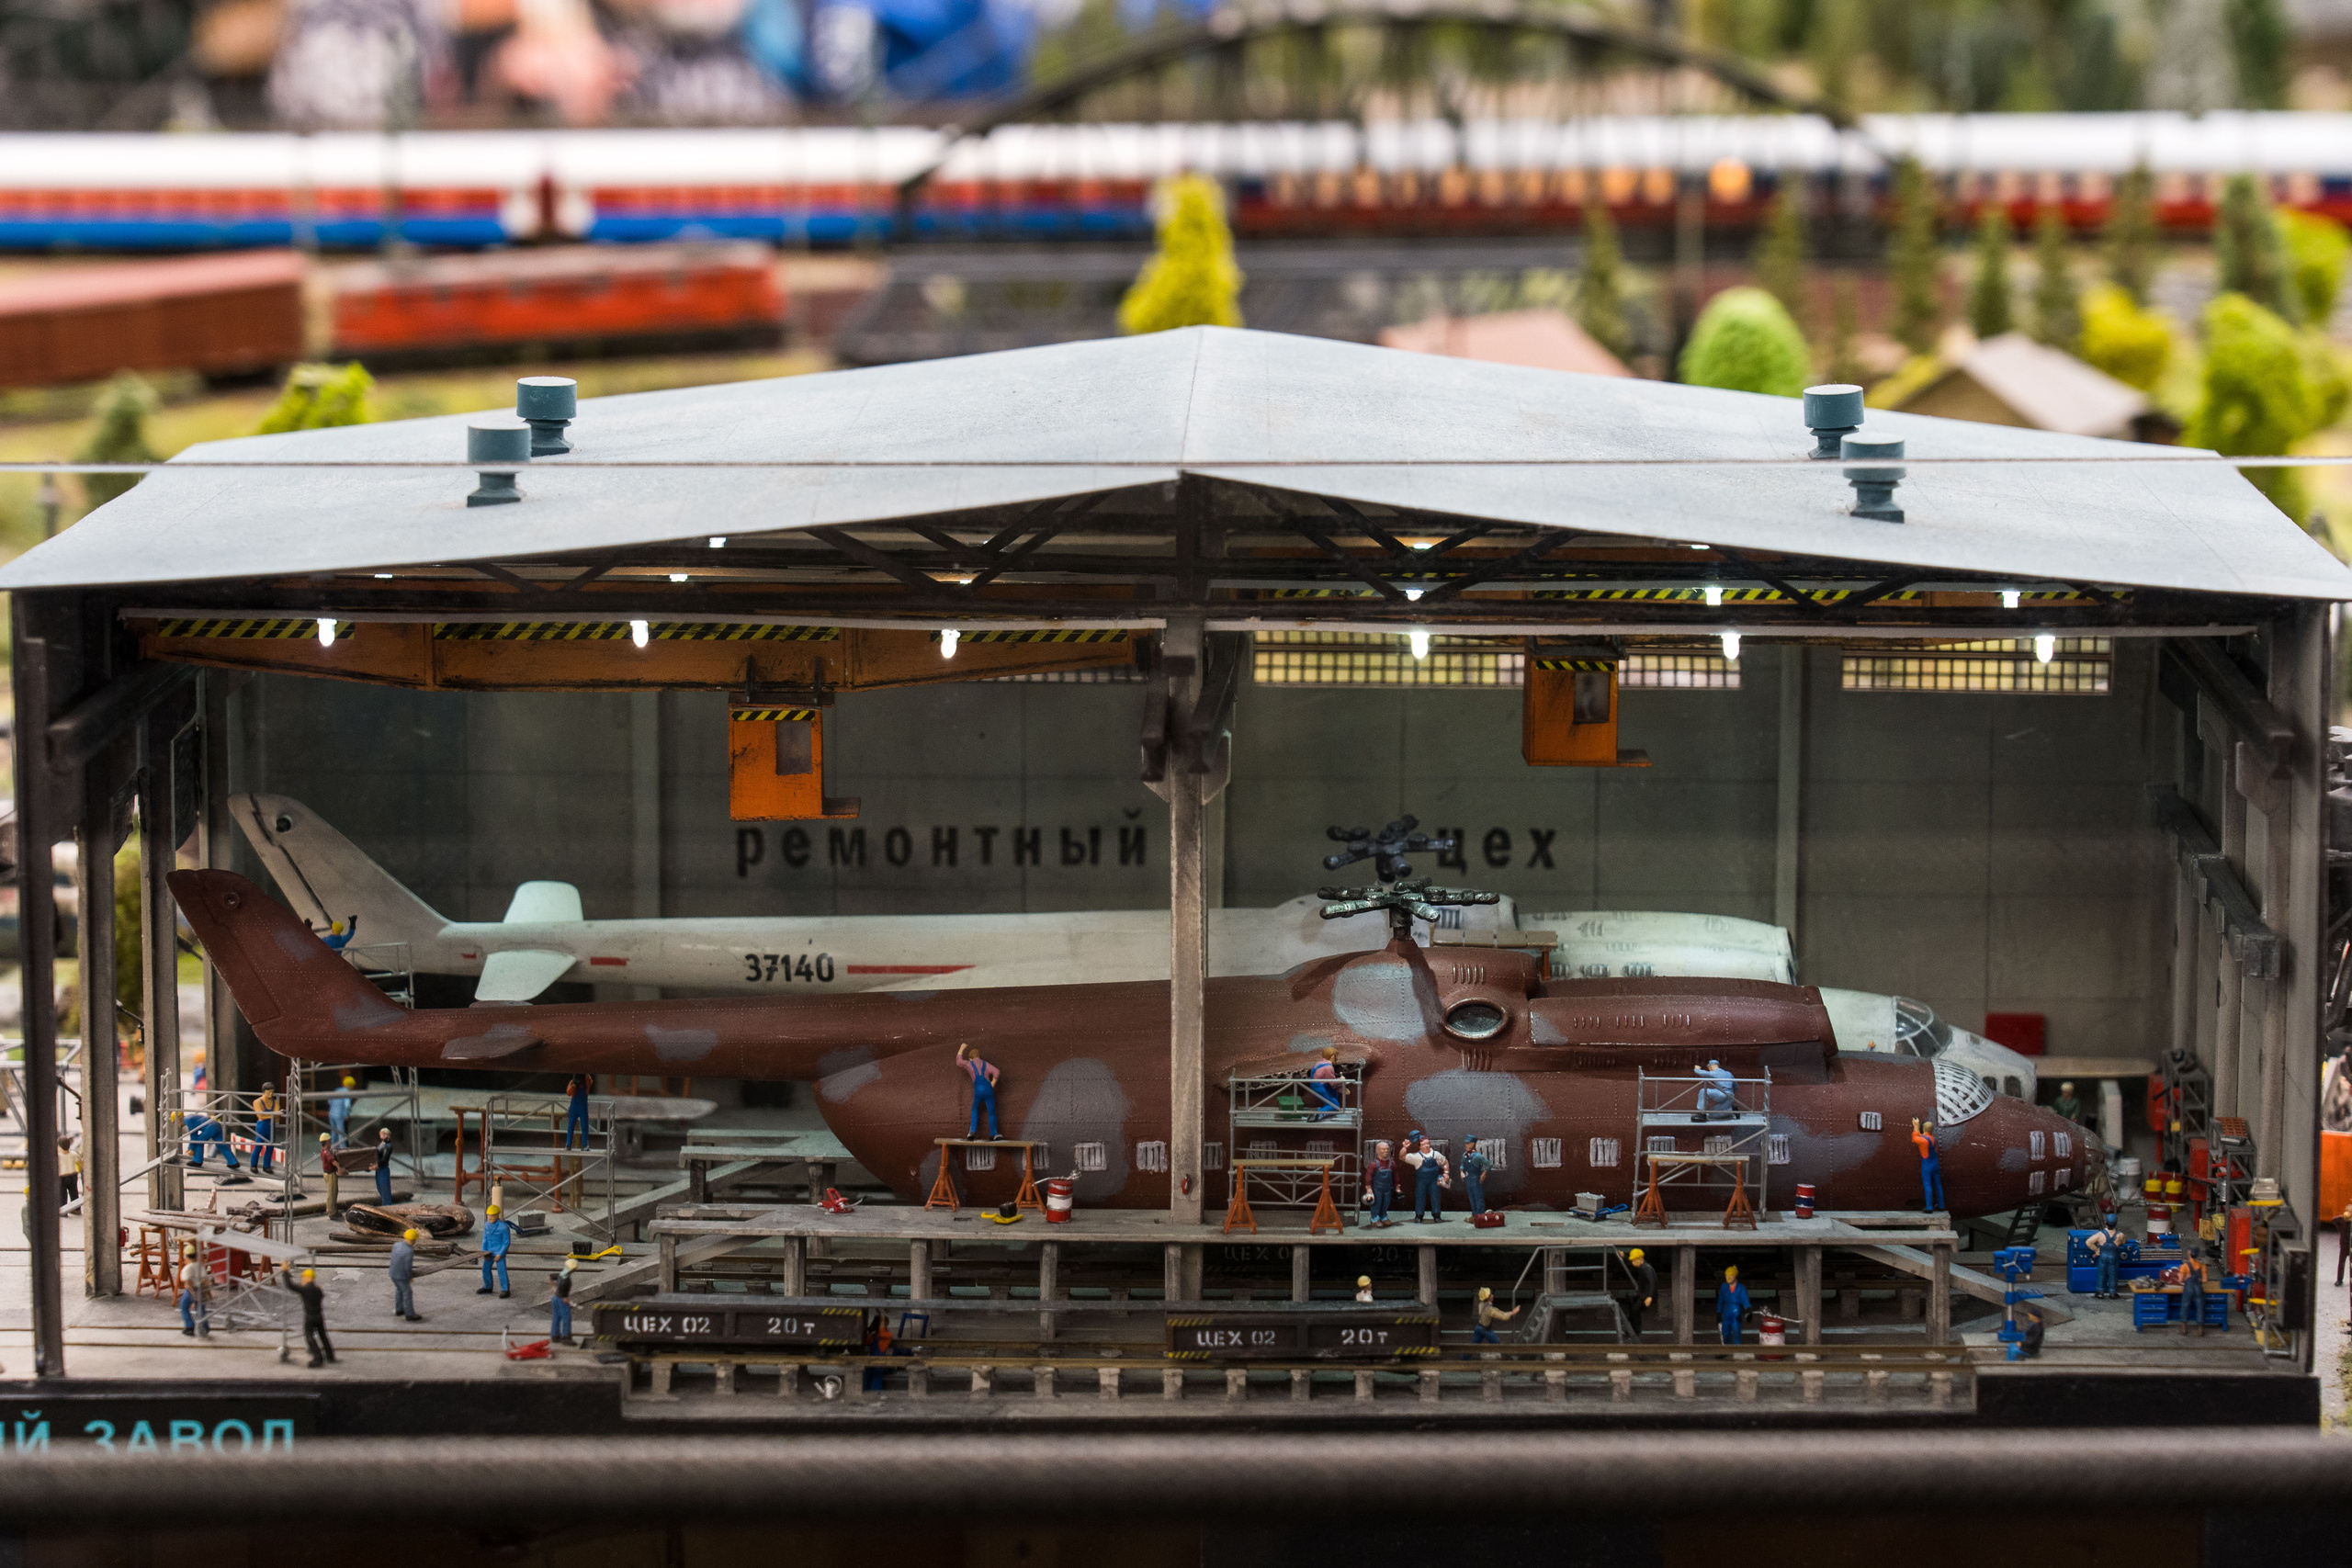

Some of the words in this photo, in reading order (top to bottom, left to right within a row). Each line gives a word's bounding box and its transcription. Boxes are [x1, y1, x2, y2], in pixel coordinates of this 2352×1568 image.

[737, 807, 1147, 877] ремонтный
[1438, 828, 1556, 874] цех
[744, 953, 835, 983] 37140
[624, 1316, 673, 1334] ЦЕХ
[682, 1316, 711, 1333] 02
[1196, 1330, 1243, 1347] ЦЕХ
[1251, 1330, 1276, 1345] 02
[0, 1410, 50, 1456] Й
